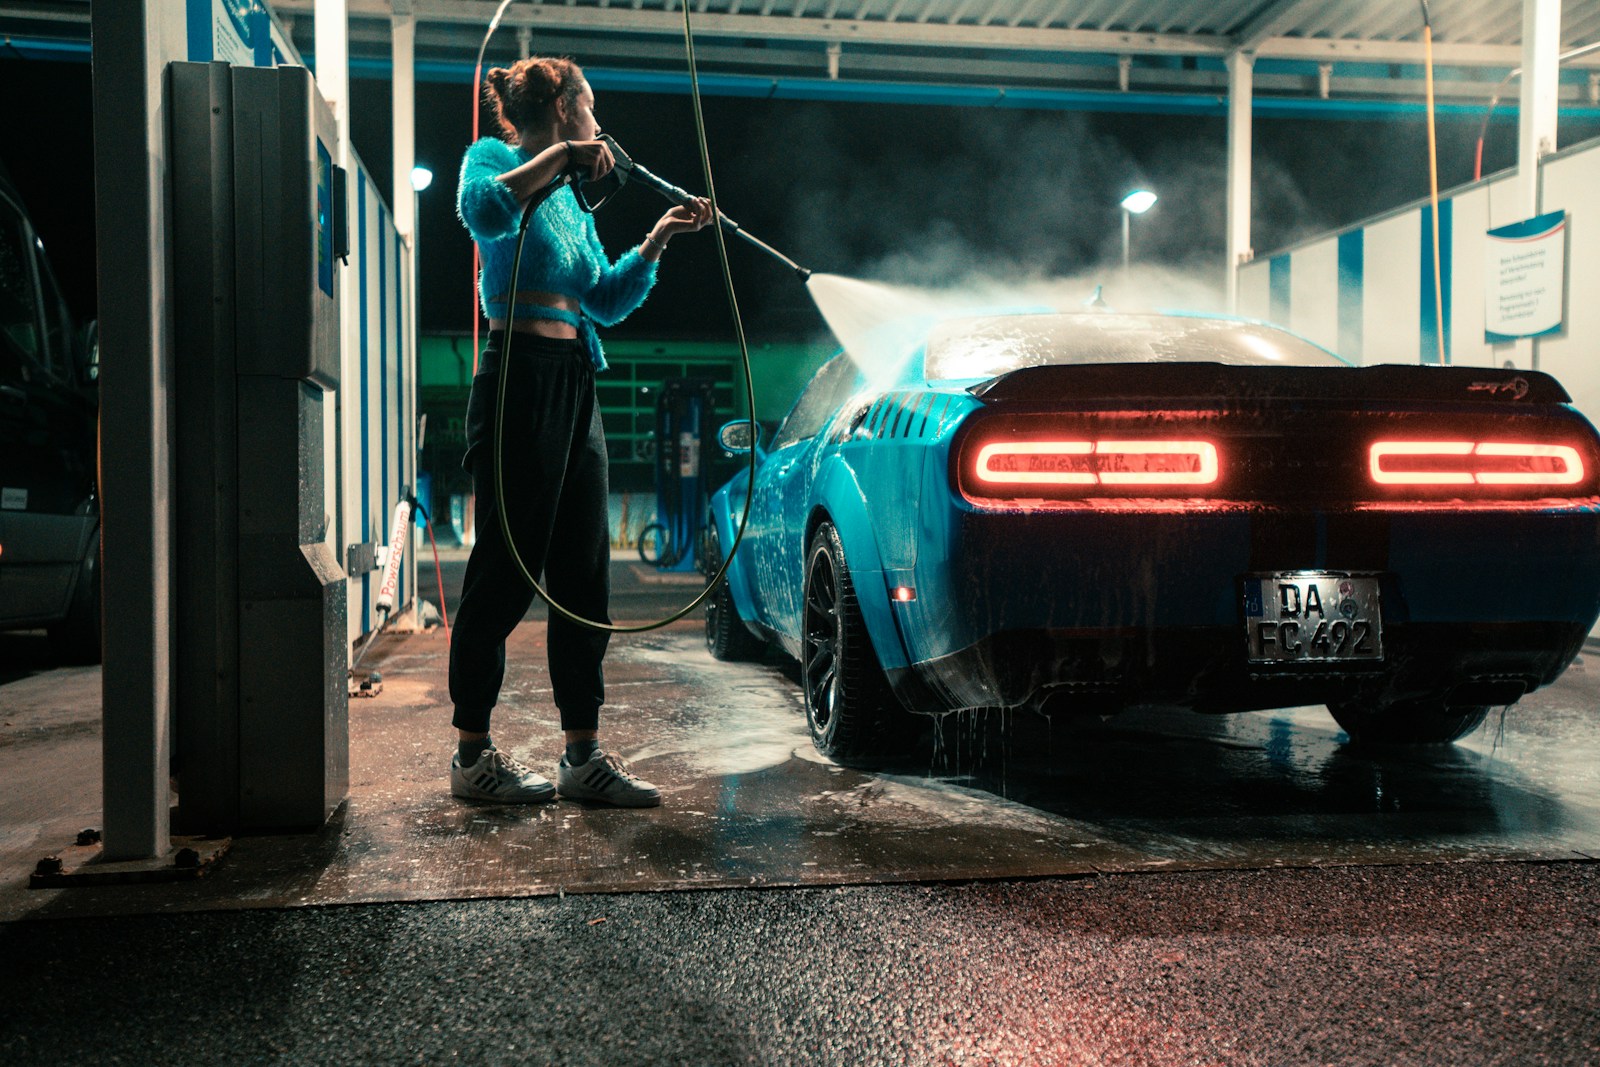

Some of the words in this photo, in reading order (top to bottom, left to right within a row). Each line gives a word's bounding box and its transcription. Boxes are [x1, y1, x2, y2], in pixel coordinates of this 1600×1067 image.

[381, 511, 409, 597] Powerschaum
[1279, 584, 1325, 619] DA
[1258, 620, 1301, 655] FC
[1310, 620, 1374, 655] 492
